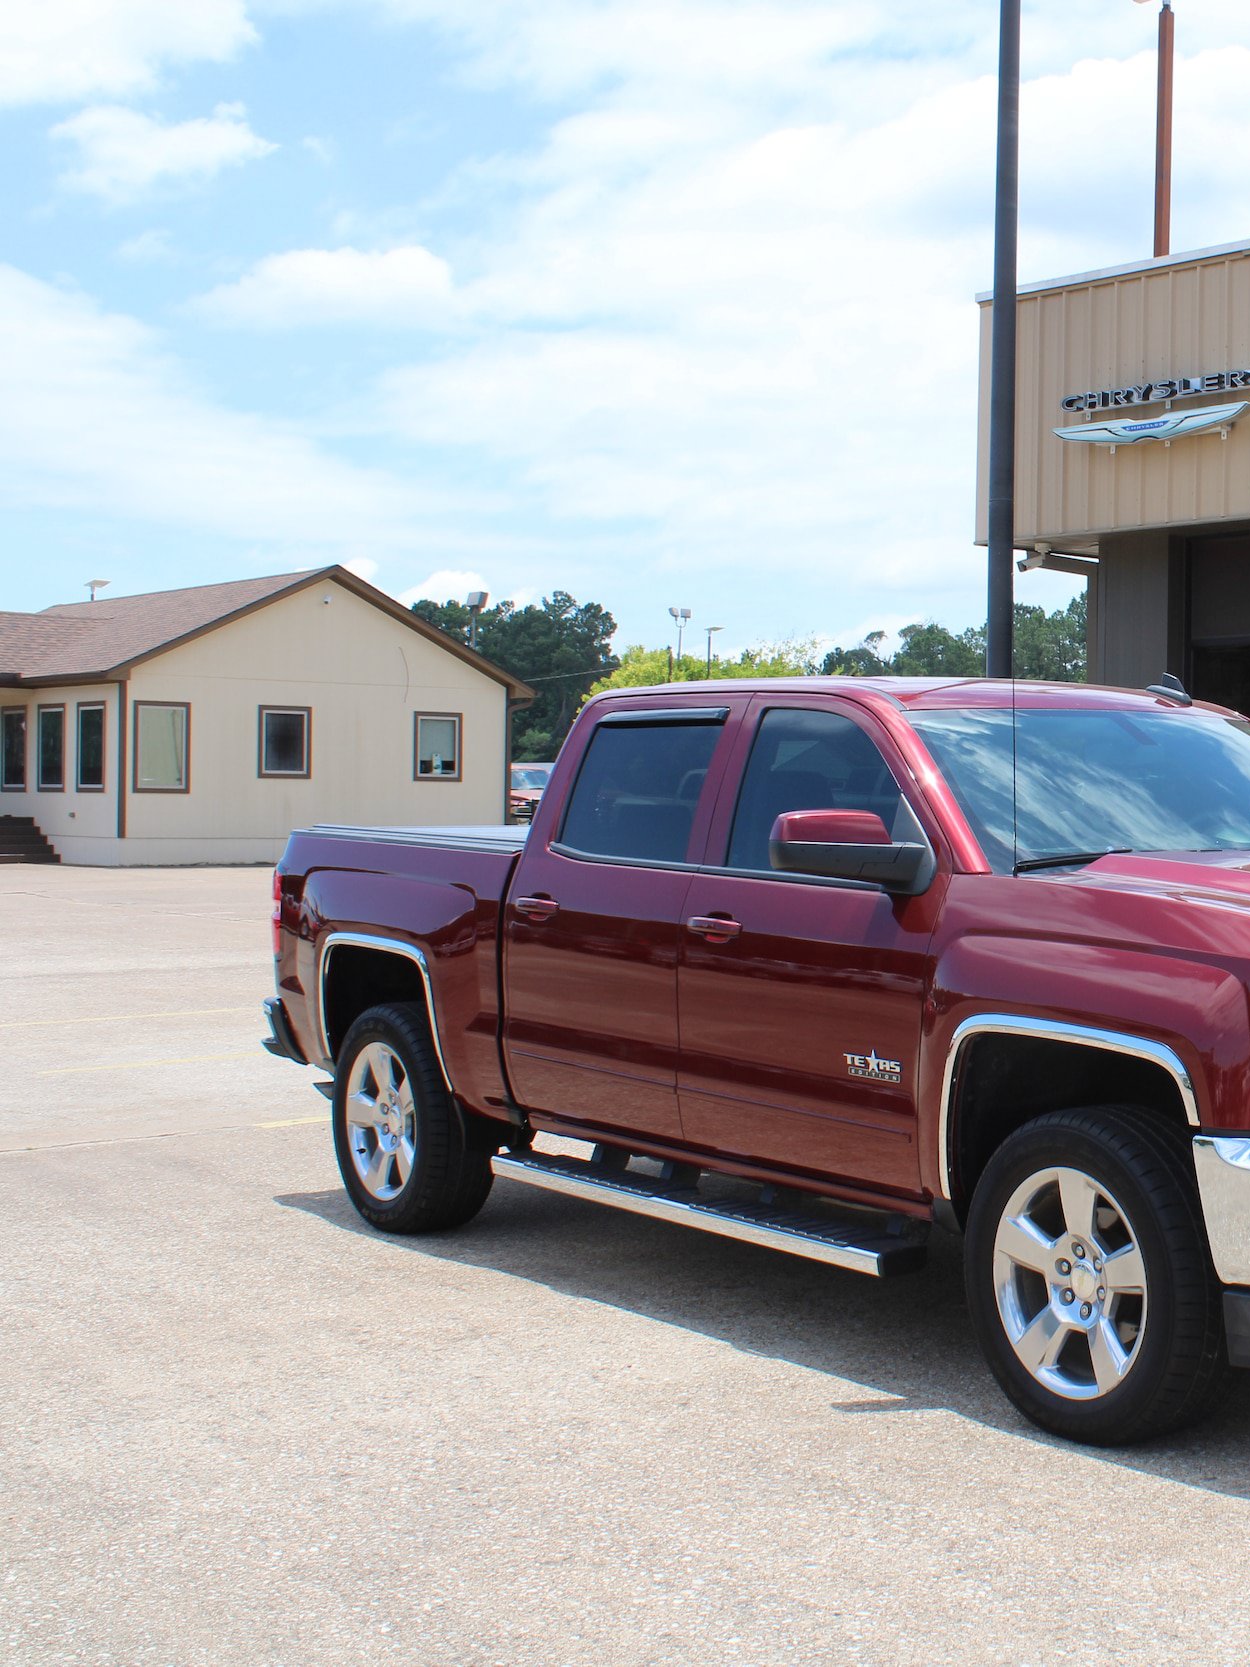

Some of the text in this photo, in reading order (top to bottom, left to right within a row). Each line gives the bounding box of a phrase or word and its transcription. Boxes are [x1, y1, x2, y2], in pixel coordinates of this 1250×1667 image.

[1061, 371, 1250, 412] CHRYSLER
[1125, 421, 1165, 432] CHRYSLER
[843, 1049, 901, 1072] TEXAS
[851, 1067, 898, 1081] EDITION
